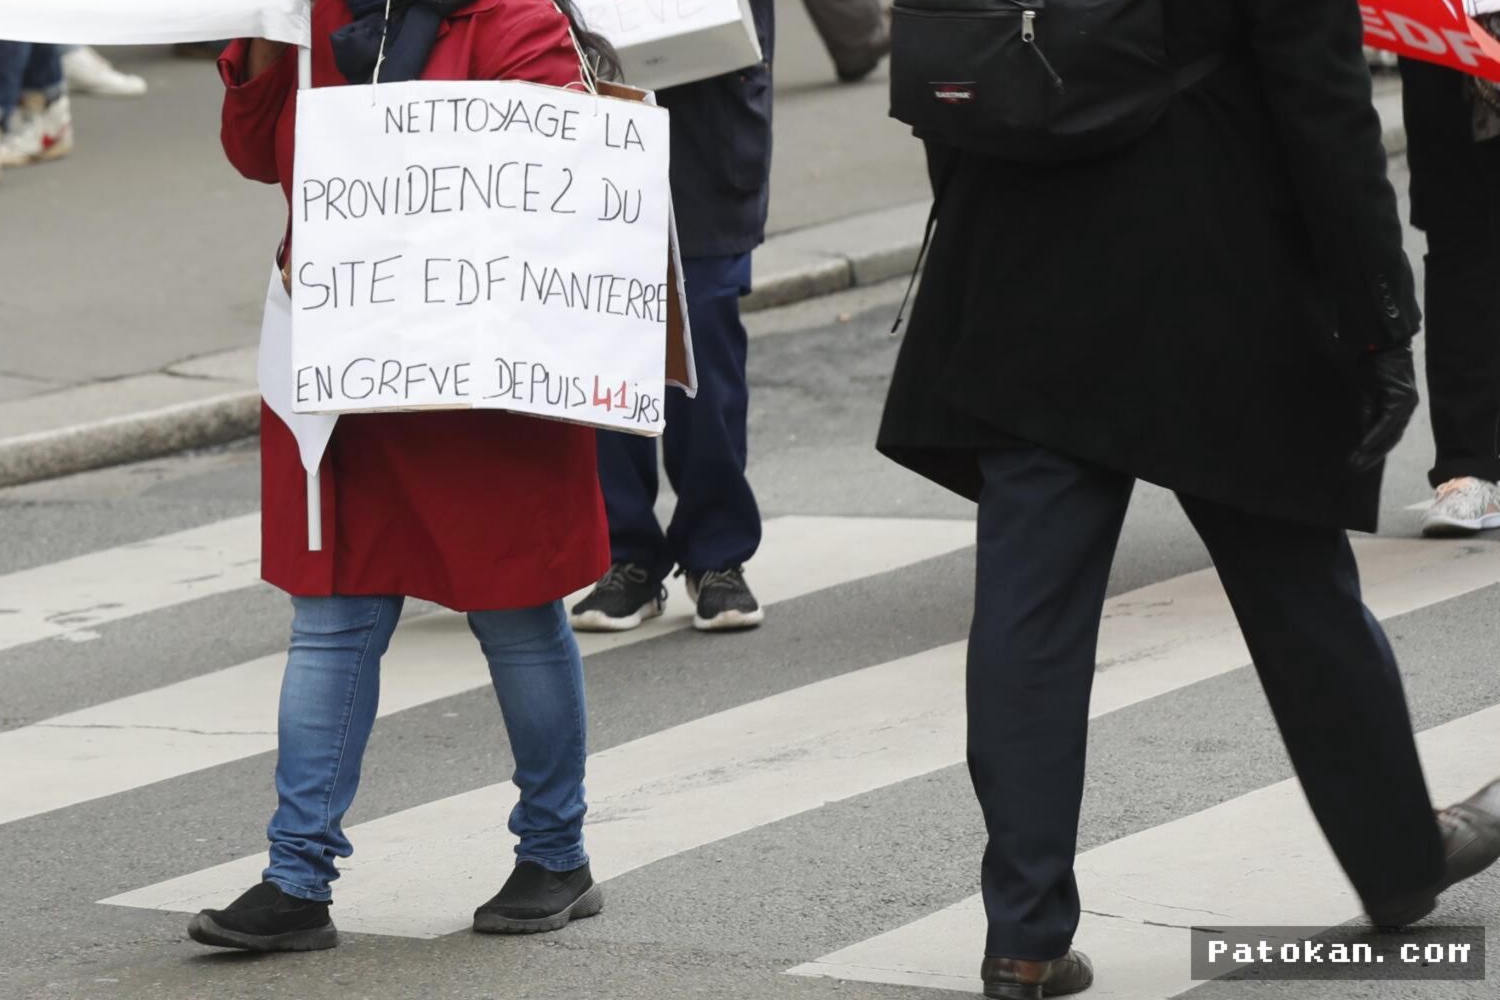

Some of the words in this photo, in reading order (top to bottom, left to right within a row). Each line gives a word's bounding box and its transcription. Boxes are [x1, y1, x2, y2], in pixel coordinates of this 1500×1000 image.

[385, 97, 580, 142] NETTOYAGE
[605, 112, 646, 152] LA
[597, 177, 642, 224] DU
[299, 255, 403, 310] SITE
[423, 256, 510, 307] EDF
[520, 260, 668, 323] NANTERRE
[296, 365, 332, 403] EN
[482, 357, 587, 409] DEPUIS
